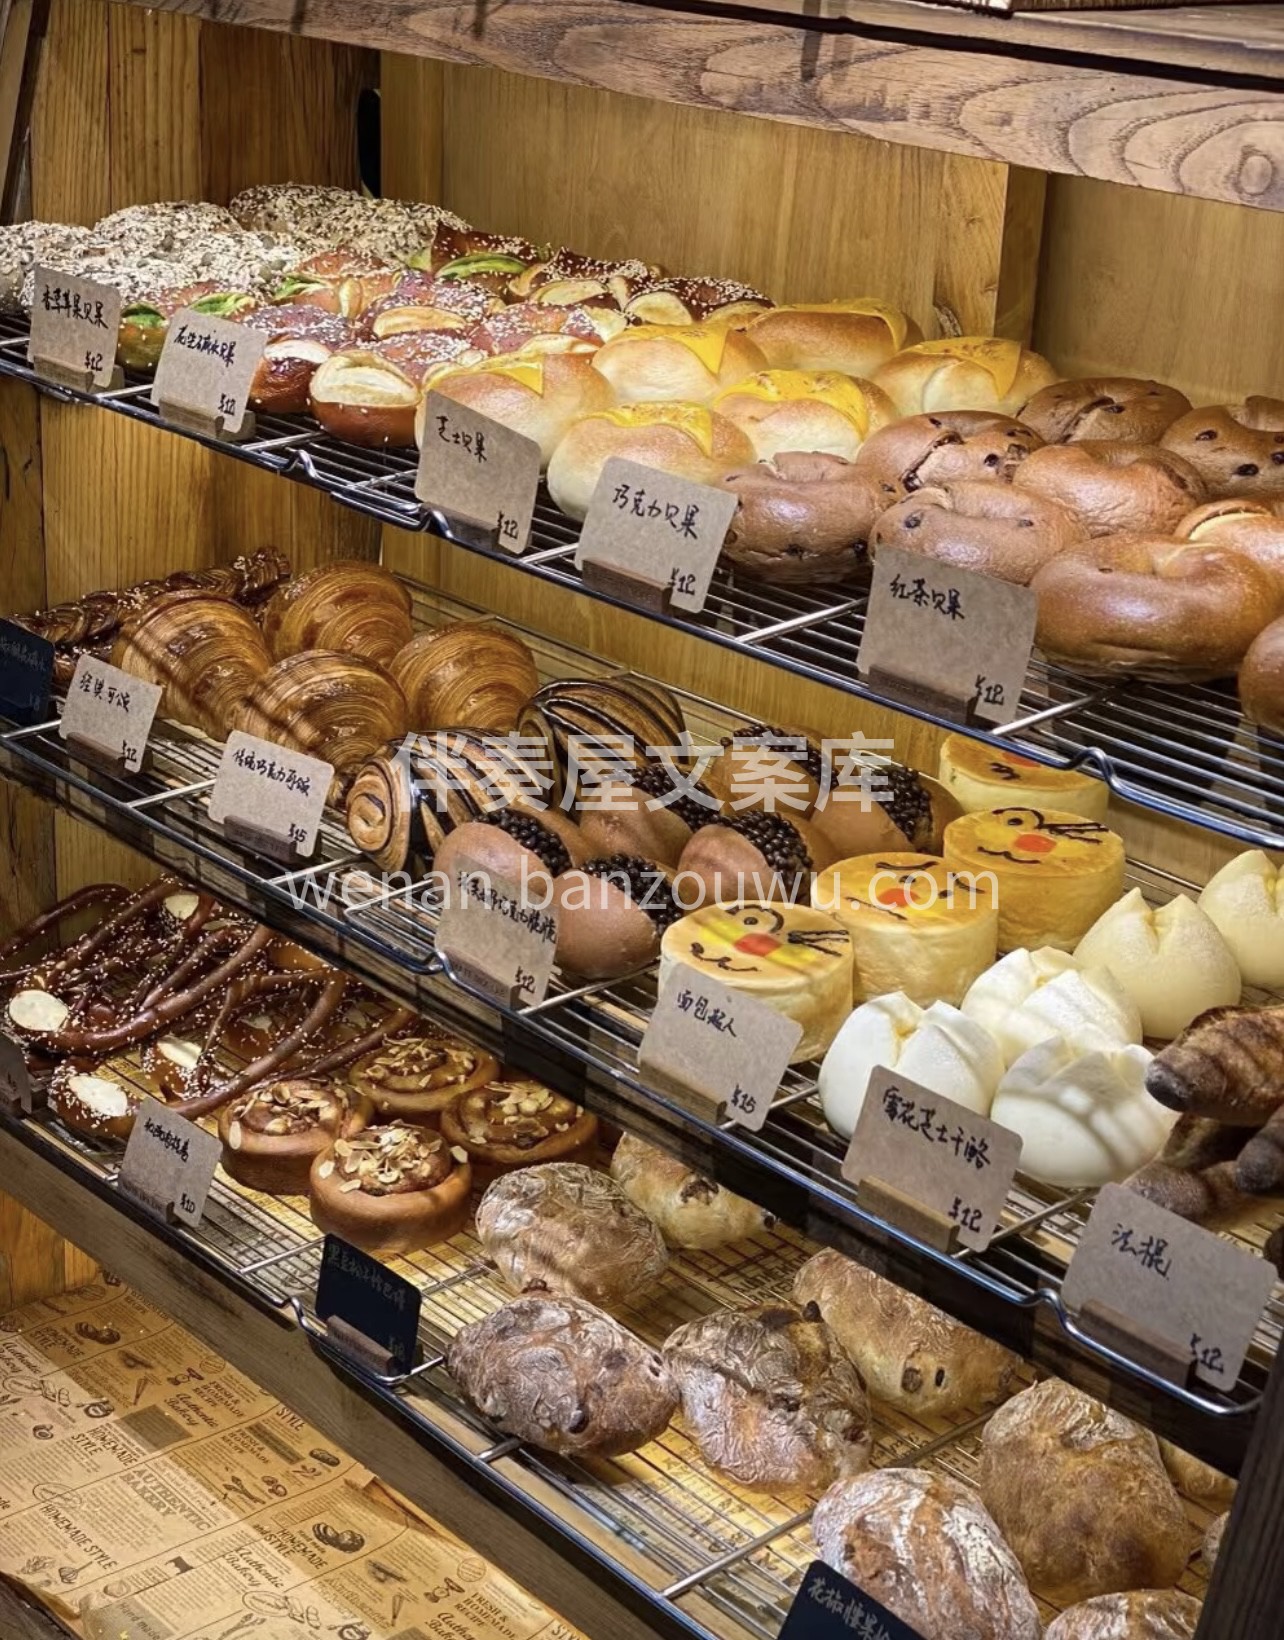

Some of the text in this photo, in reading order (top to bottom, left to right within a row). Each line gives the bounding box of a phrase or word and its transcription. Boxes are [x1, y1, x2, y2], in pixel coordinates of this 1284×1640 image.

[435, 415, 487, 463] 芝士贝果
[613, 483, 699, 540] 巧克力贝果
[667, 567, 696, 596] ¥12
[890, 573, 965, 620] 红茶贝果
[79, 671, 131, 713] 经典可颂
[974, 674, 1005, 706] ¥12
[676, 990, 737, 1038] 面包超人
[731, 1083, 757, 1114] ¥15
[947, 1197, 984, 1233] ¥12
[1111, 1222, 1172, 1278] 法棍
[276, 1406, 305, 1432] STYLE
[71, 1433, 104, 1456] STYLE
[86, 1427, 138, 1467] HOMEMADE
[119, 1473, 178, 1517] BAKERY
[132, 1469, 212, 1531] AUTHENTIC
[40, 1503, 93, 1548] HOMEMADE
[83, 1545, 118, 1570] STYLE
[263, 1533, 296, 1559] STYLE
[277, 1529, 328, 1570] HOMEMADE
